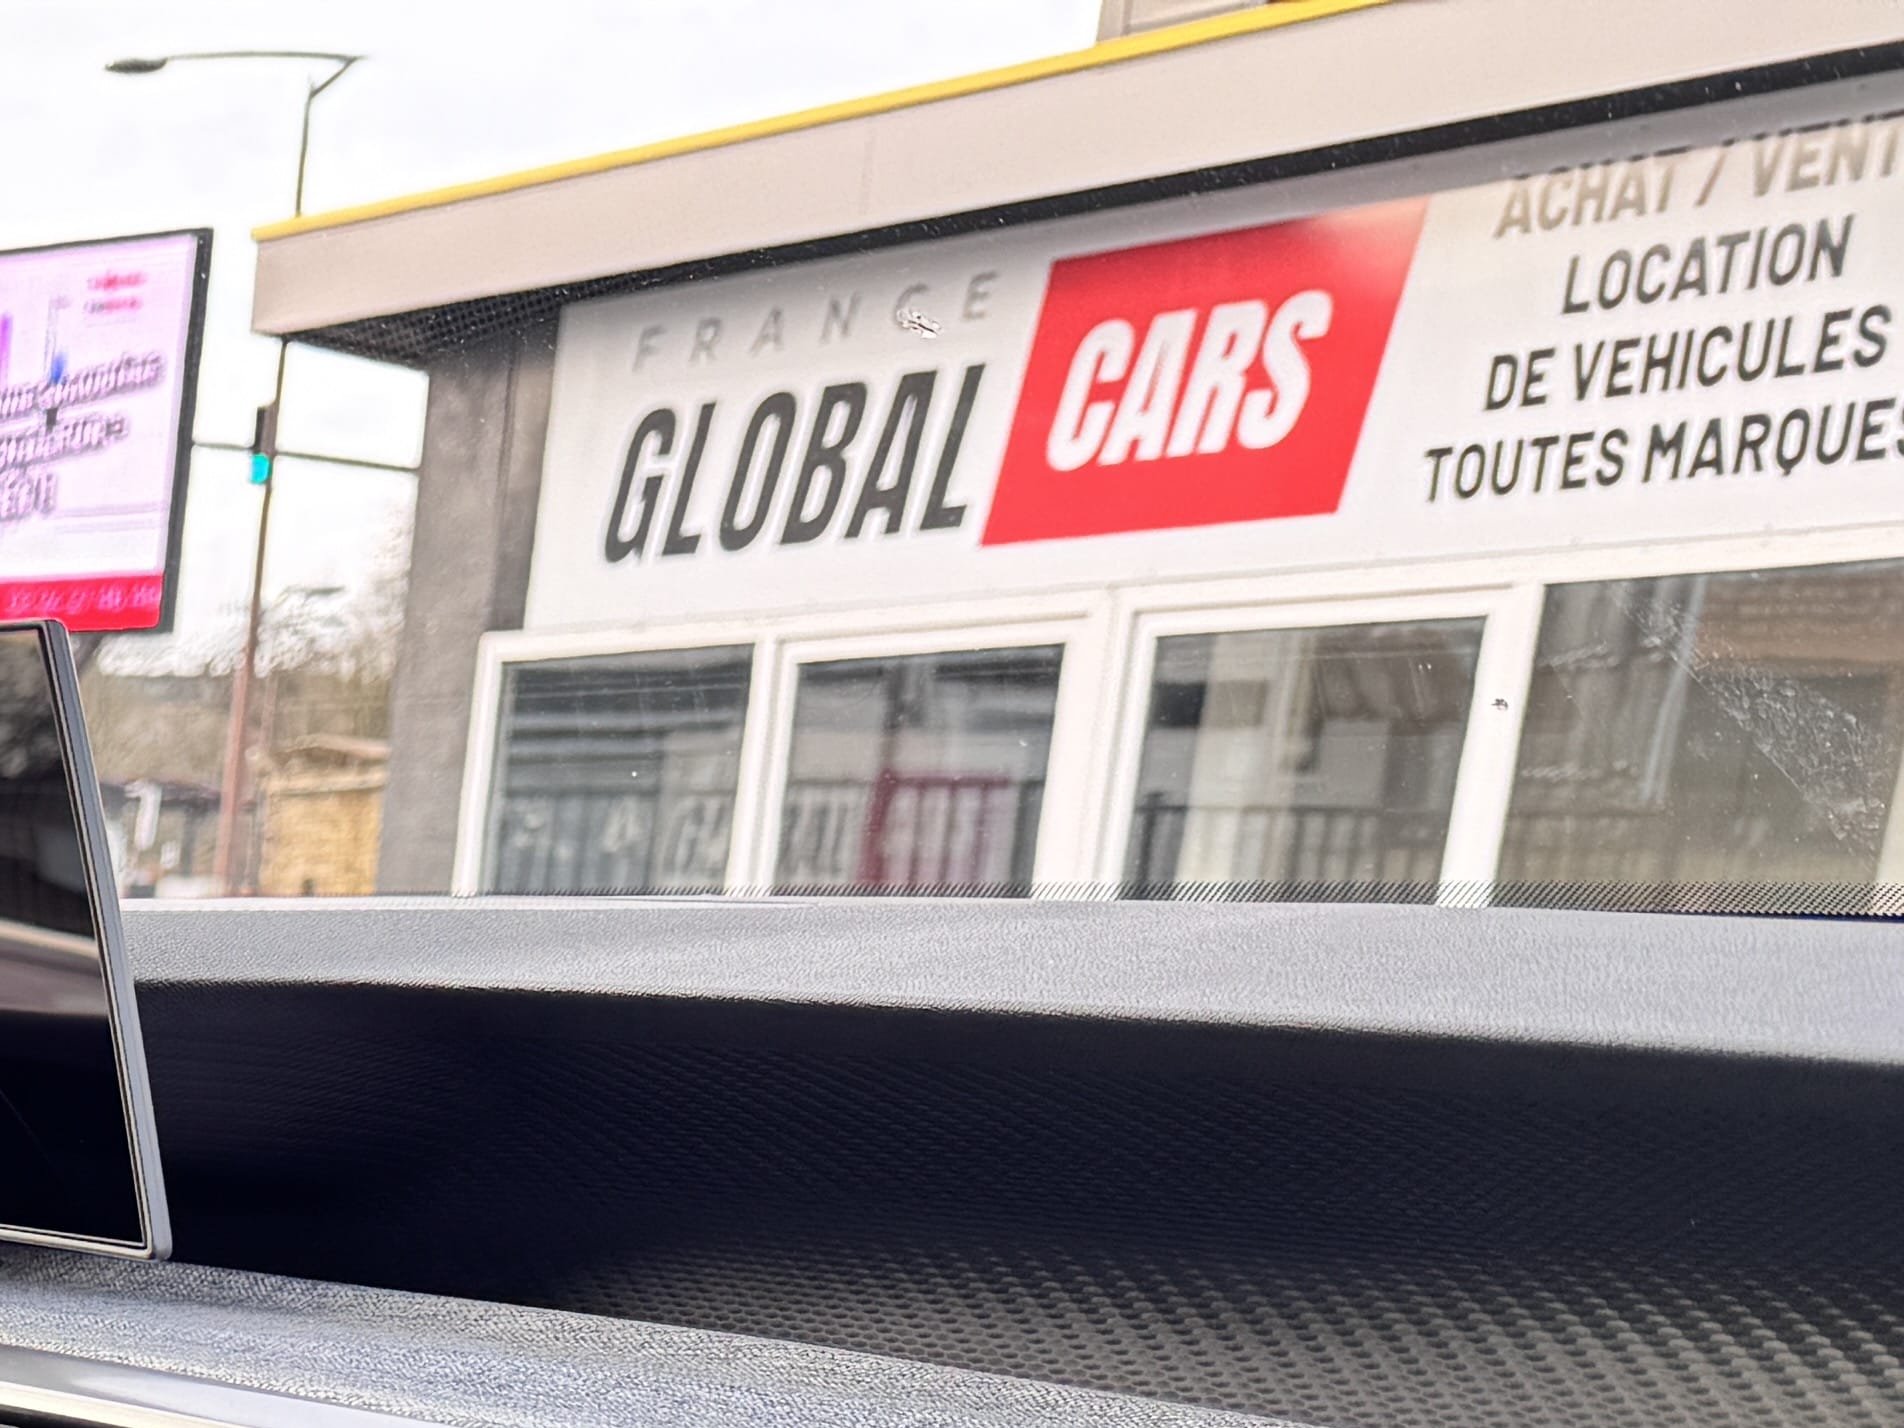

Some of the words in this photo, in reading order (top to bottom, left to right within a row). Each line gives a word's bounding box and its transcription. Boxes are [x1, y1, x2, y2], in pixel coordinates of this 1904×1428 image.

[1493, 145, 1691, 239] ACHAT
[1562, 214, 1855, 315] LOCATION
[633, 270, 1000, 372] FRANCE
[1484, 348, 1556, 411] DE
[1574, 305, 1892, 400] VEHICULES
[1046, 290, 1333, 471] CARS
[604, 363, 987, 563] GLOBAL
[1424, 428, 1629, 502] TOUTES
